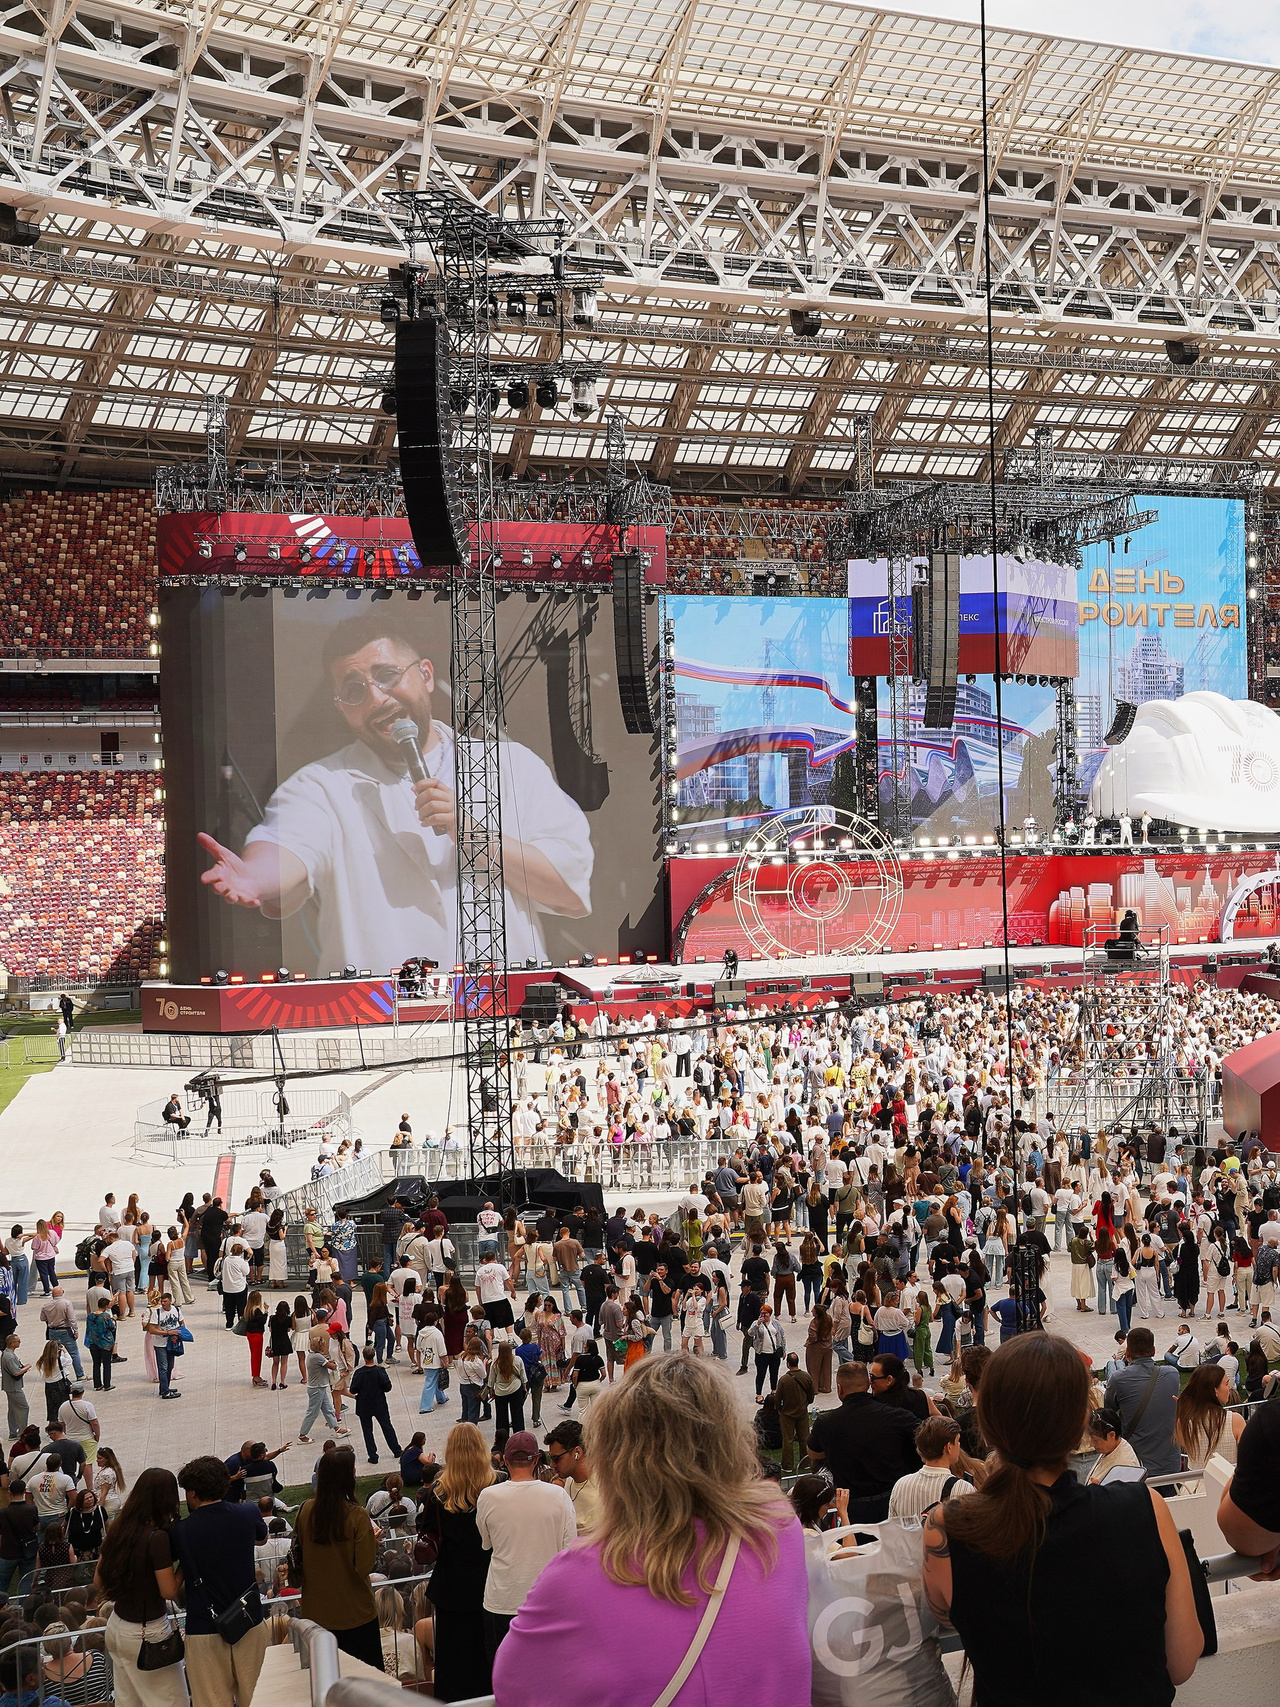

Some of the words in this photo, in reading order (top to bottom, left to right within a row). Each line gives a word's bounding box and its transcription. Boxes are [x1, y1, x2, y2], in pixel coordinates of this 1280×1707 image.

[1088, 567, 1185, 594] ДЕНЬ
[1078, 601, 1240, 628] РОИТЕЛЯ
[1217, 744, 1279, 792] 70
[155, 997, 179, 1020] 70
[812, 1581, 924, 1678] GJ
